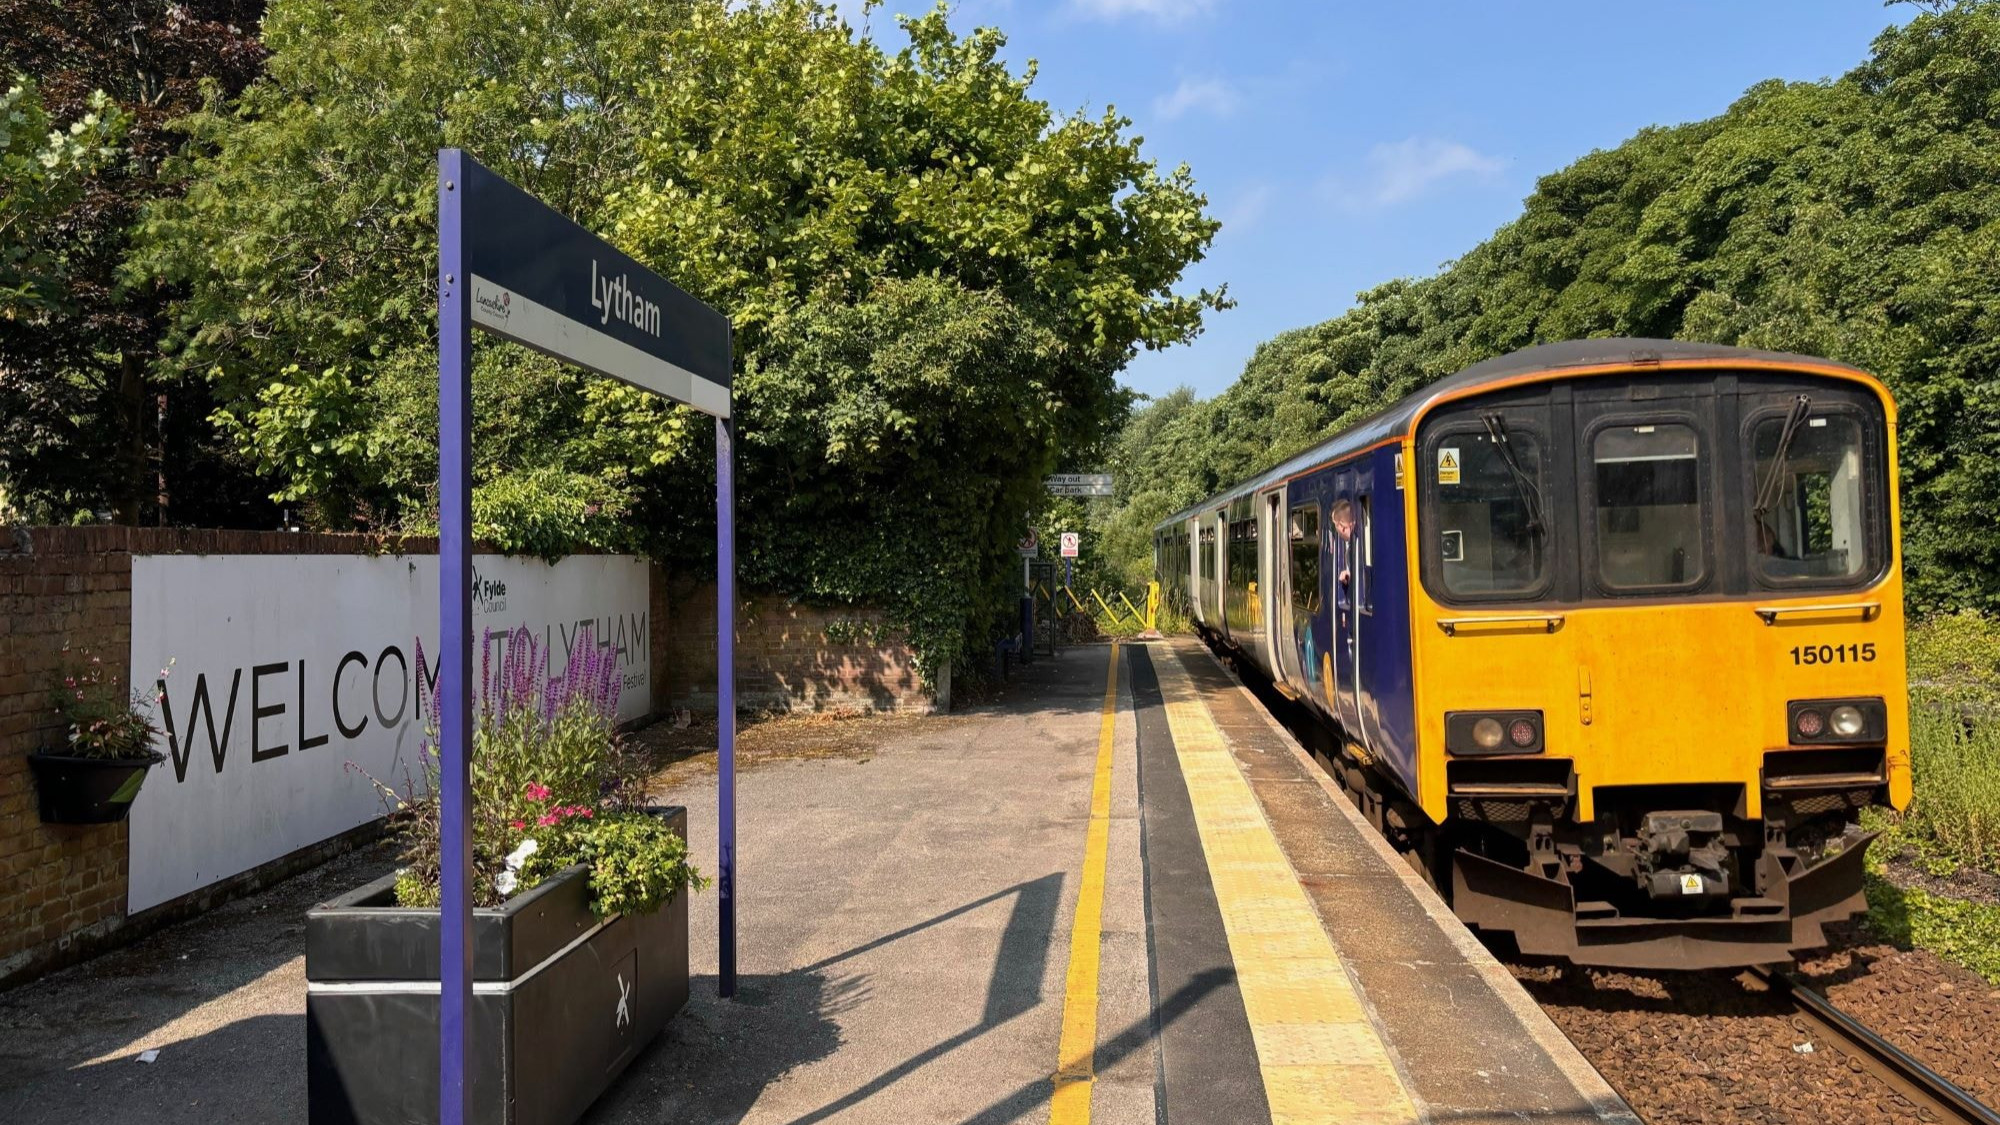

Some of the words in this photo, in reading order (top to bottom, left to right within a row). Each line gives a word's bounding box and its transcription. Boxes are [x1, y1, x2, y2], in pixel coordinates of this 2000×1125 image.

[591, 259, 661, 338] Lytham
[1067, 475, 1081, 483] out
[1049, 486, 1063, 494] Car
[1064, 486, 1082, 495] park
[484, 580, 506, 600] Fylde
[483, 598, 507, 614] Council
[1790, 642, 1876, 666] 150115
[622, 670, 647, 692] Festival
[157, 634, 474, 783] WELCOM
